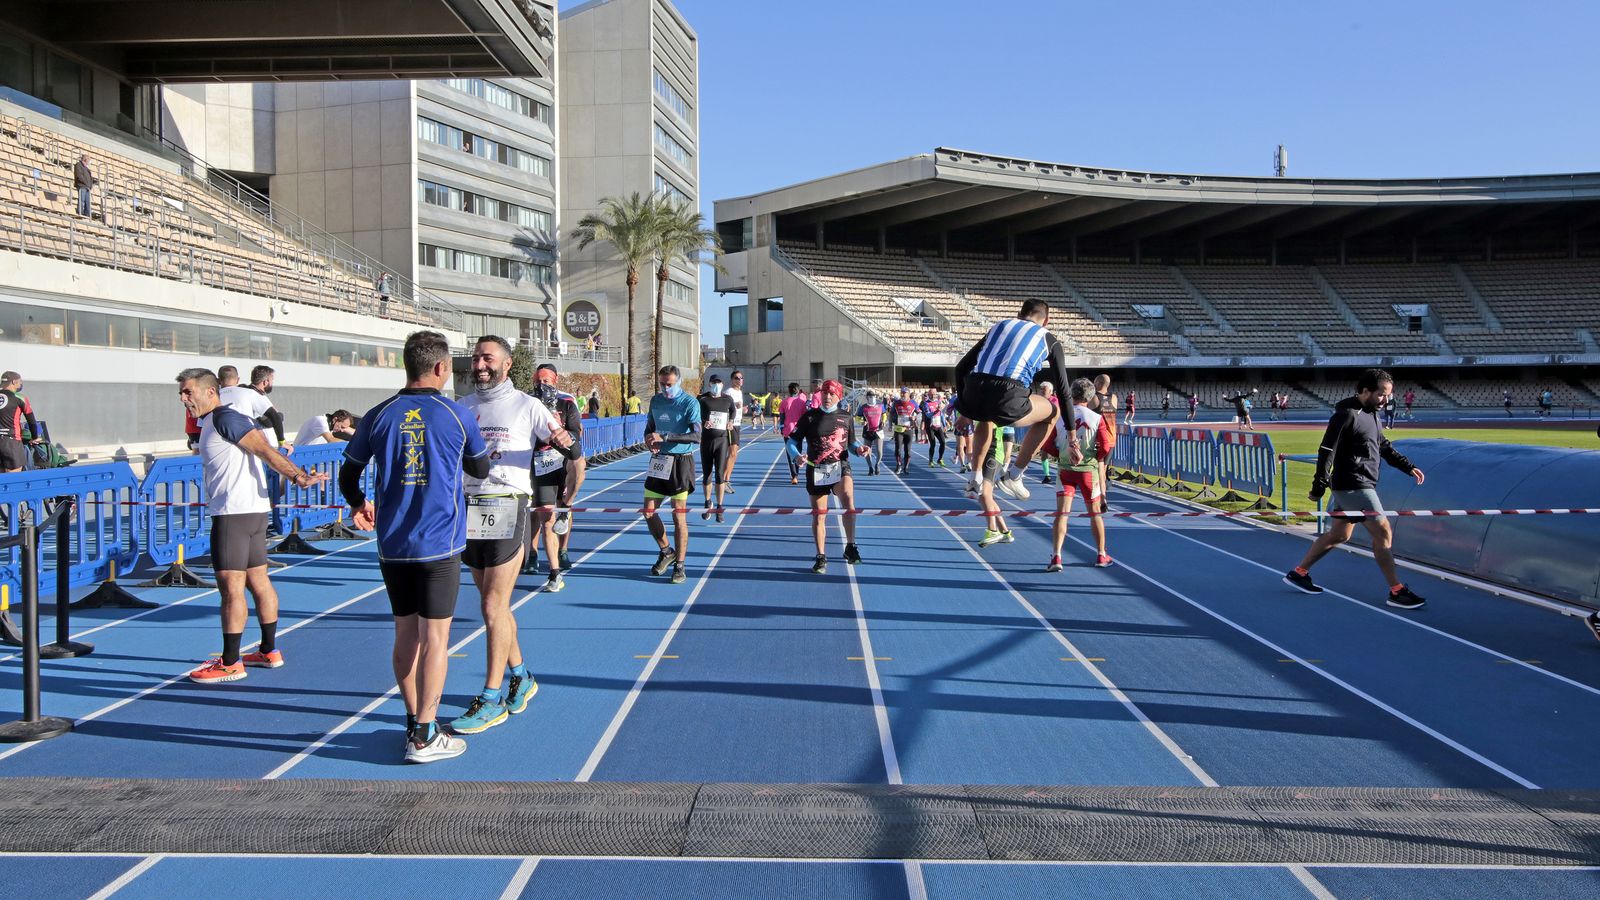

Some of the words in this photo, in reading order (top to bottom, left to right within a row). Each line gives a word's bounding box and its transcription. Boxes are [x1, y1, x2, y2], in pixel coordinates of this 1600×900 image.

[566, 311, 599, 326] B&B
[540, 459, 554, 468] 306
[481, 513, 495, 527] 76
